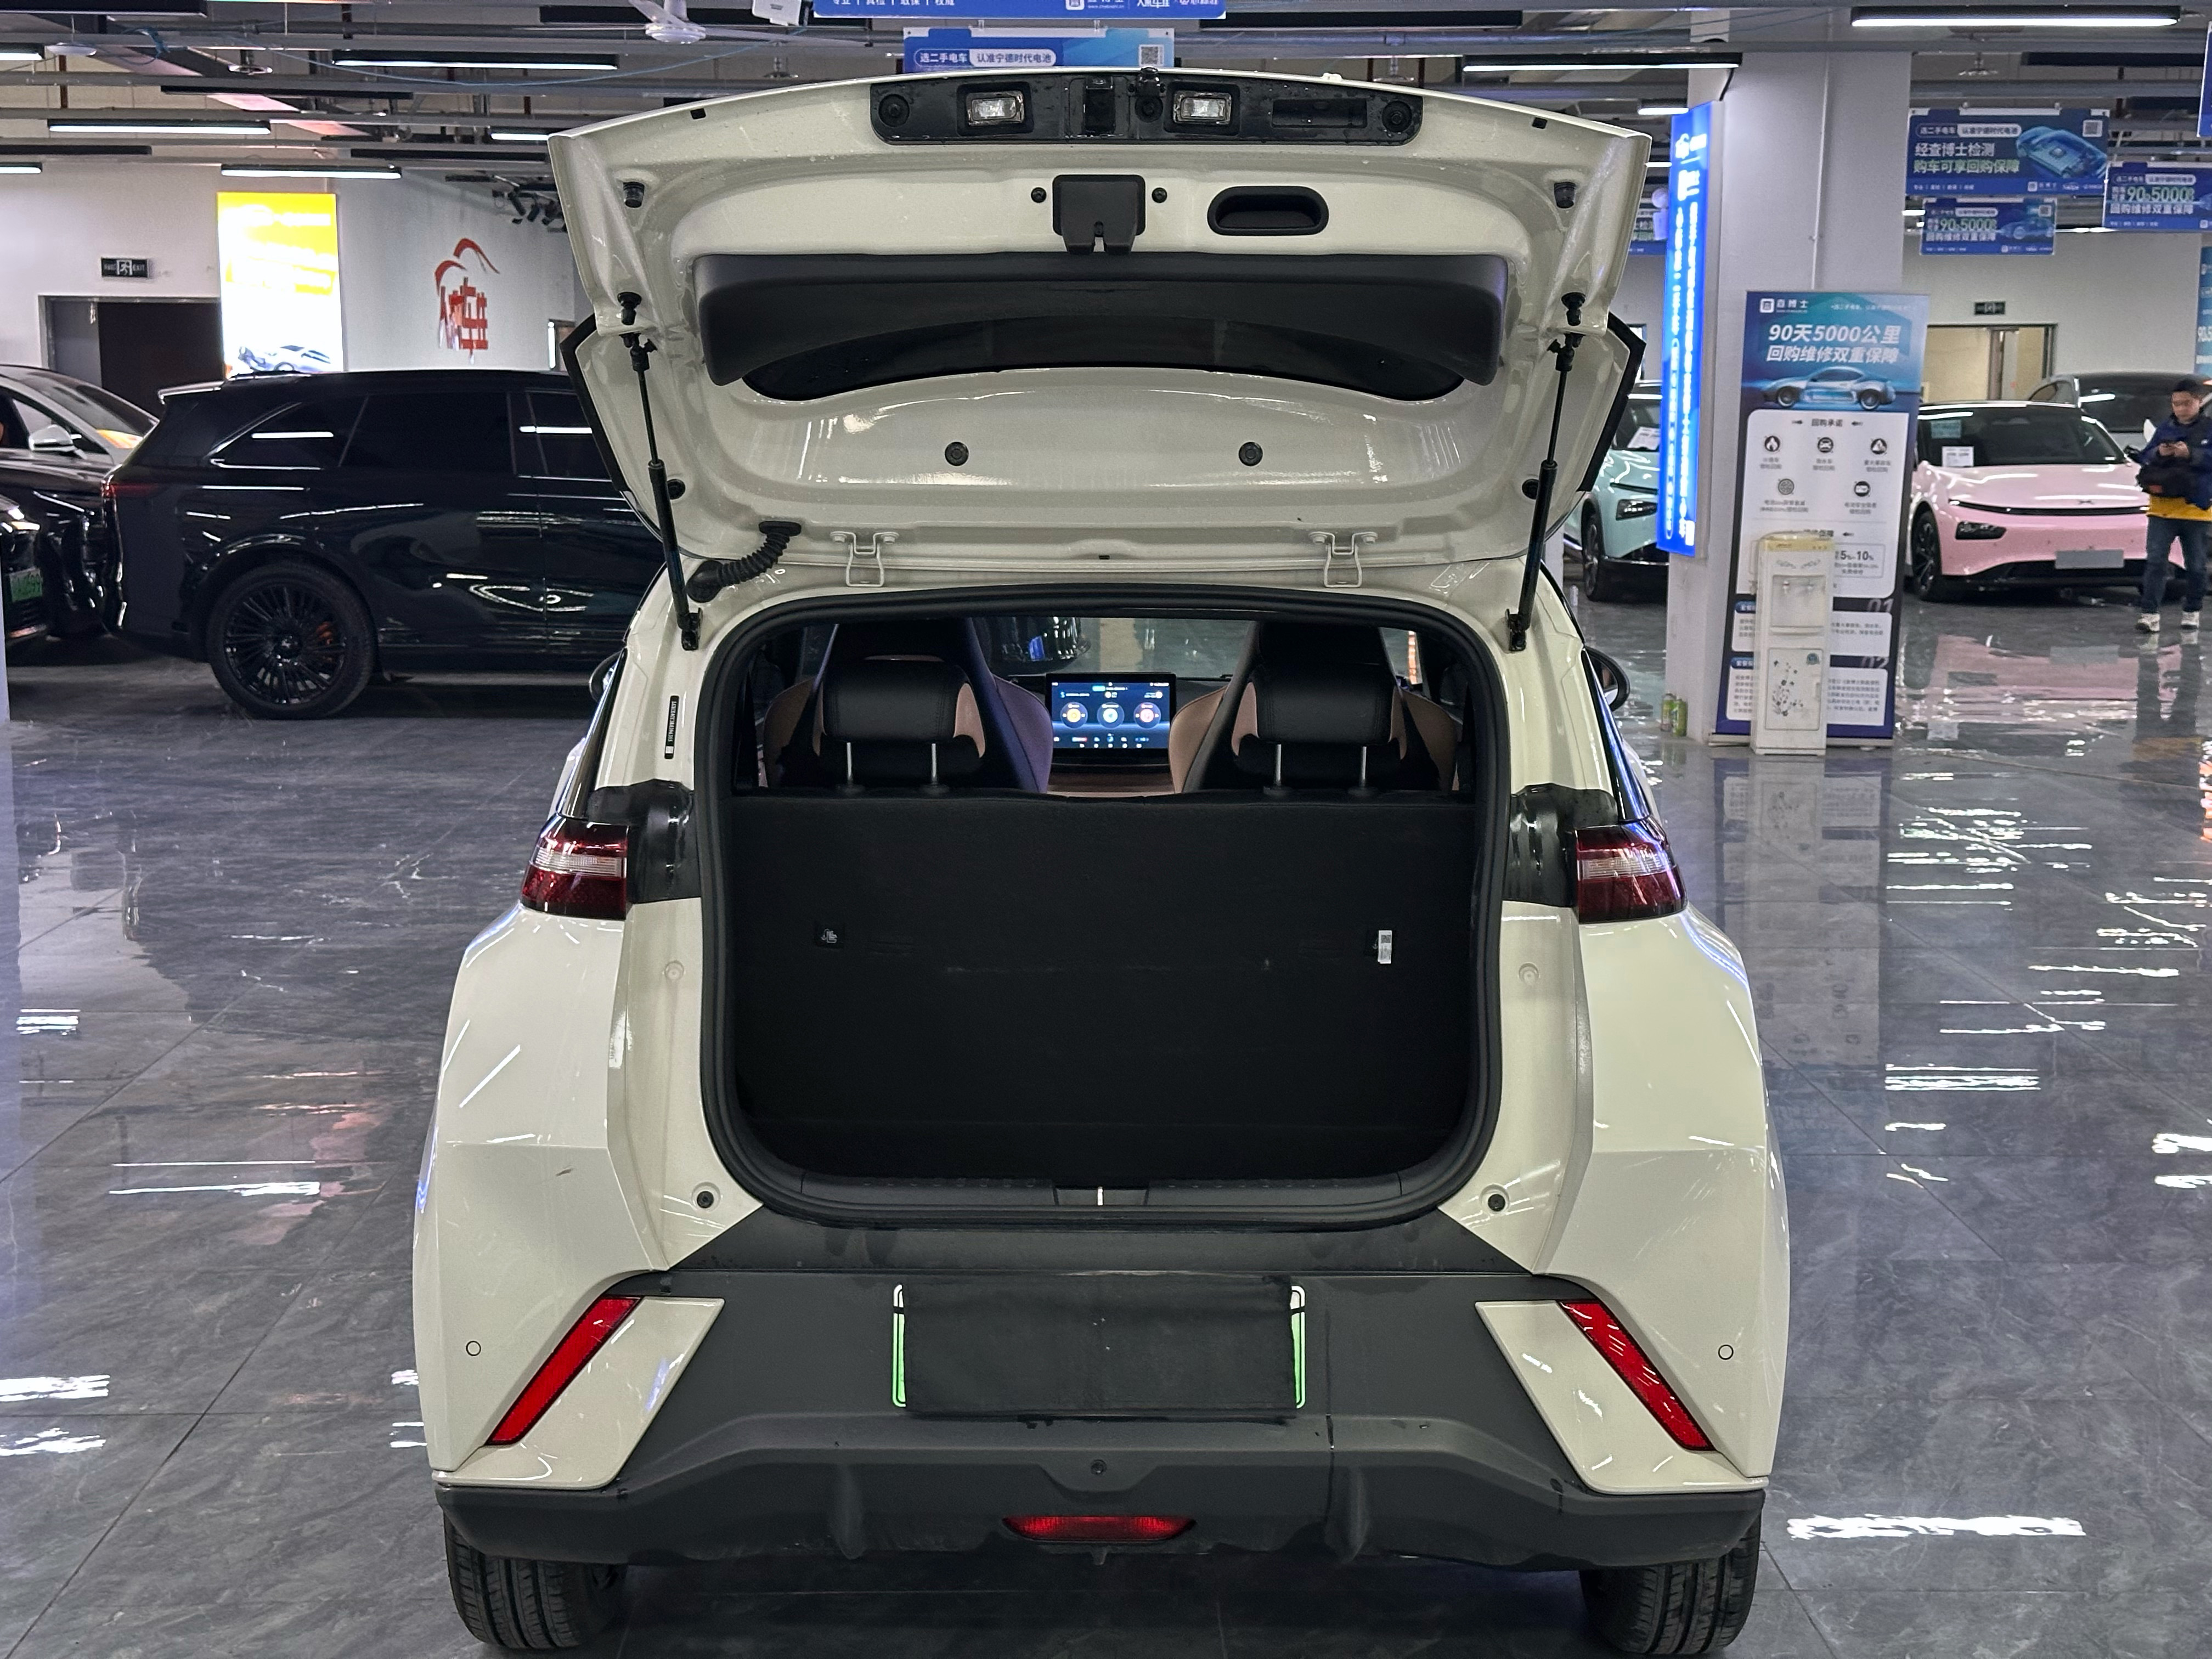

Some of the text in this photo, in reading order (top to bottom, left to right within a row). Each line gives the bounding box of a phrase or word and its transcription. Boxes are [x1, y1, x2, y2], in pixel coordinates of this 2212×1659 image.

[919, 53, 1052, 63] 选二手电车 认准宁德时代电池
[1914, 143, 1995, 157] 经查博士检测
[1913, 160, 2020, 173] 购车可享回购保障
[1768, 324, 1901, 345] 90天5000公里
[1766, 345, 1899, 364] 回购维修双重保障
[1811, 419, 1843, 427] 回购承诺
[1867, 599, 1894, 612] 01
